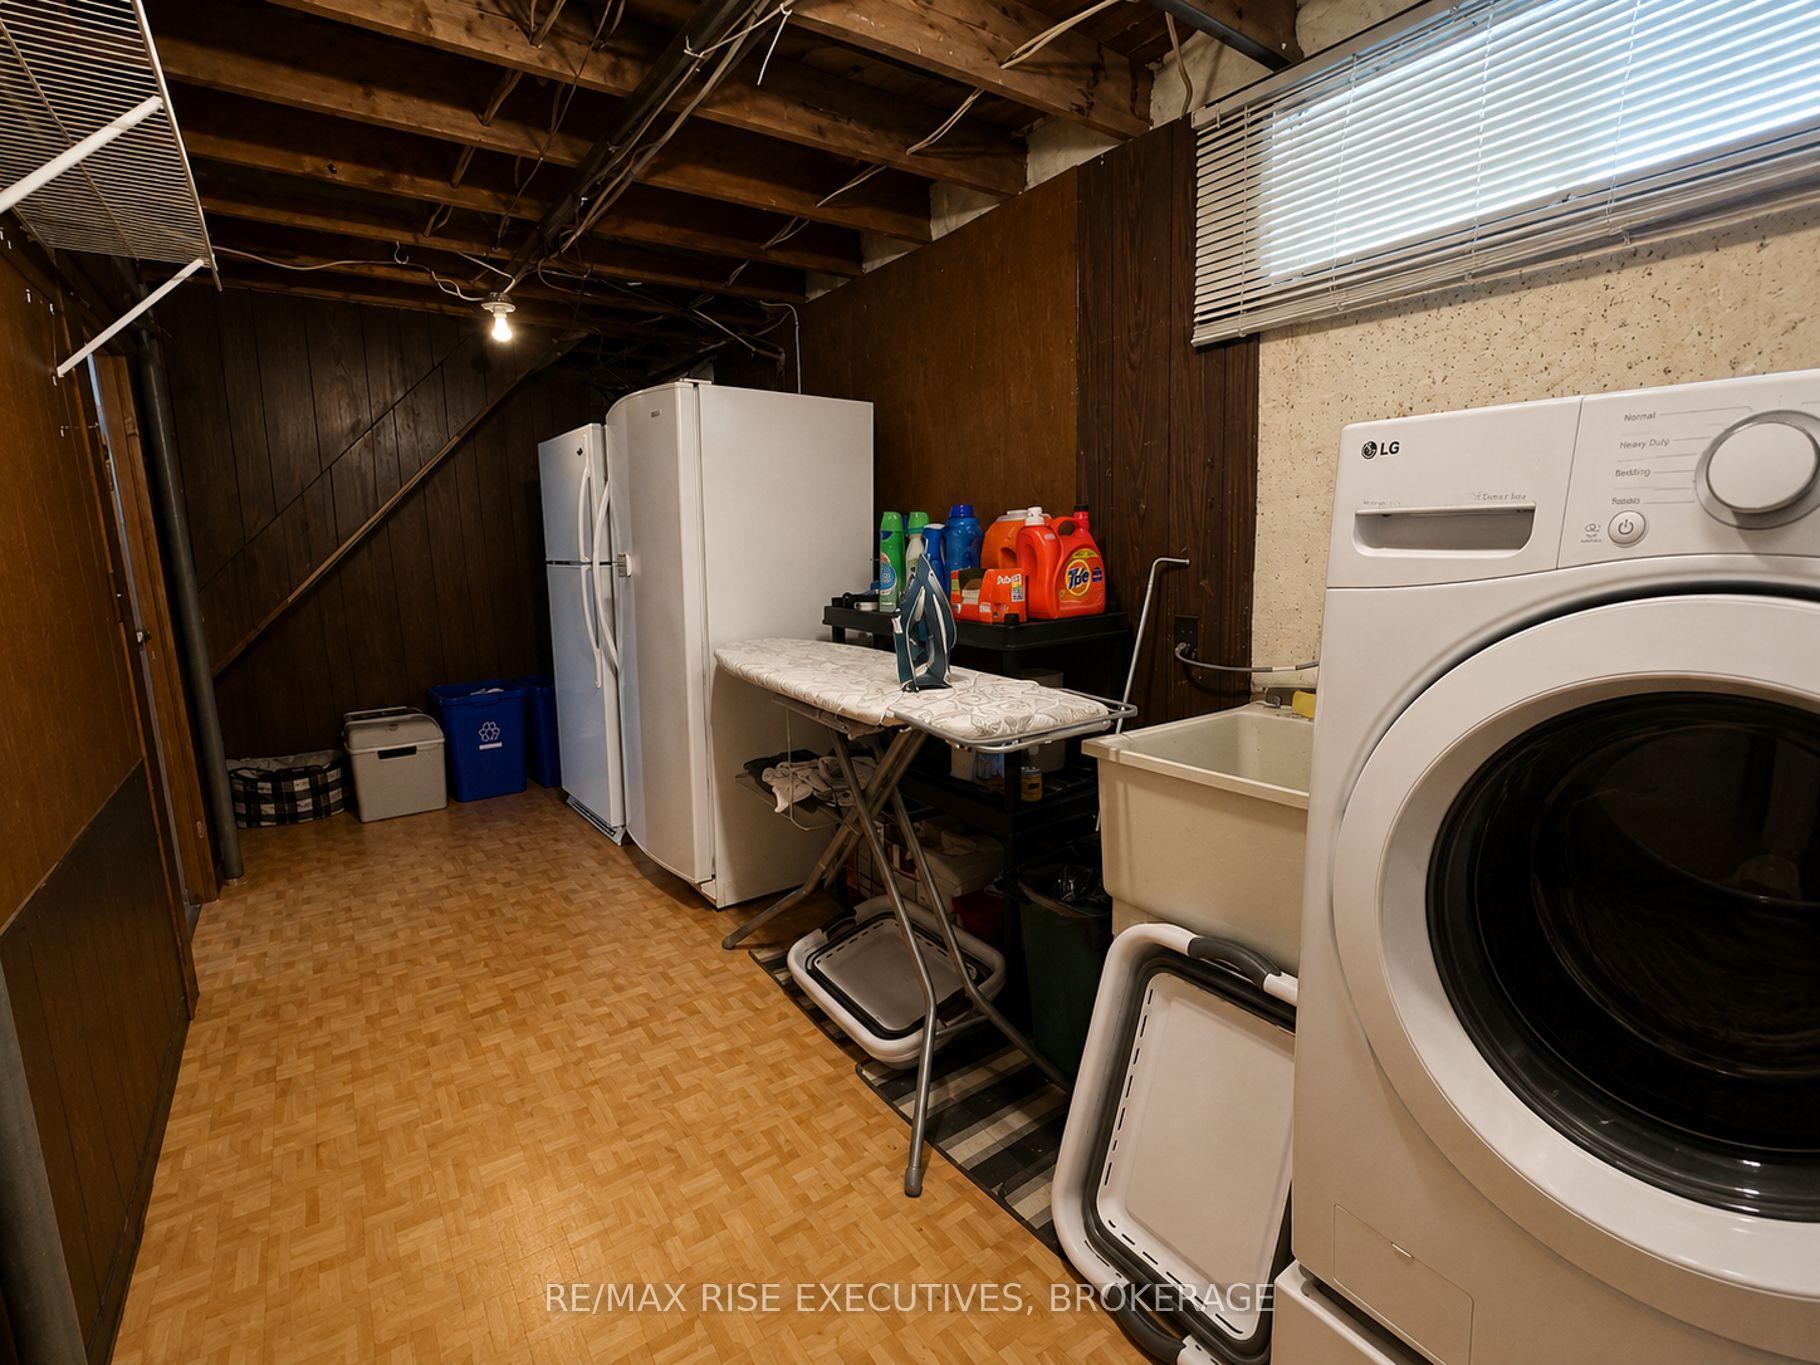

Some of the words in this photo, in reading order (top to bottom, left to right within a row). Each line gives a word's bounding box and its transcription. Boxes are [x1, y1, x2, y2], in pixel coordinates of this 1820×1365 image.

[1623, 411, 1657, 421] Normal
[1379, 441, 1400, 456] LG
[1619, 441, 1646, 450] Heavy
[1648, 438, 1670, 448] Duty
[1067, 566, 1090, 590] Tide
